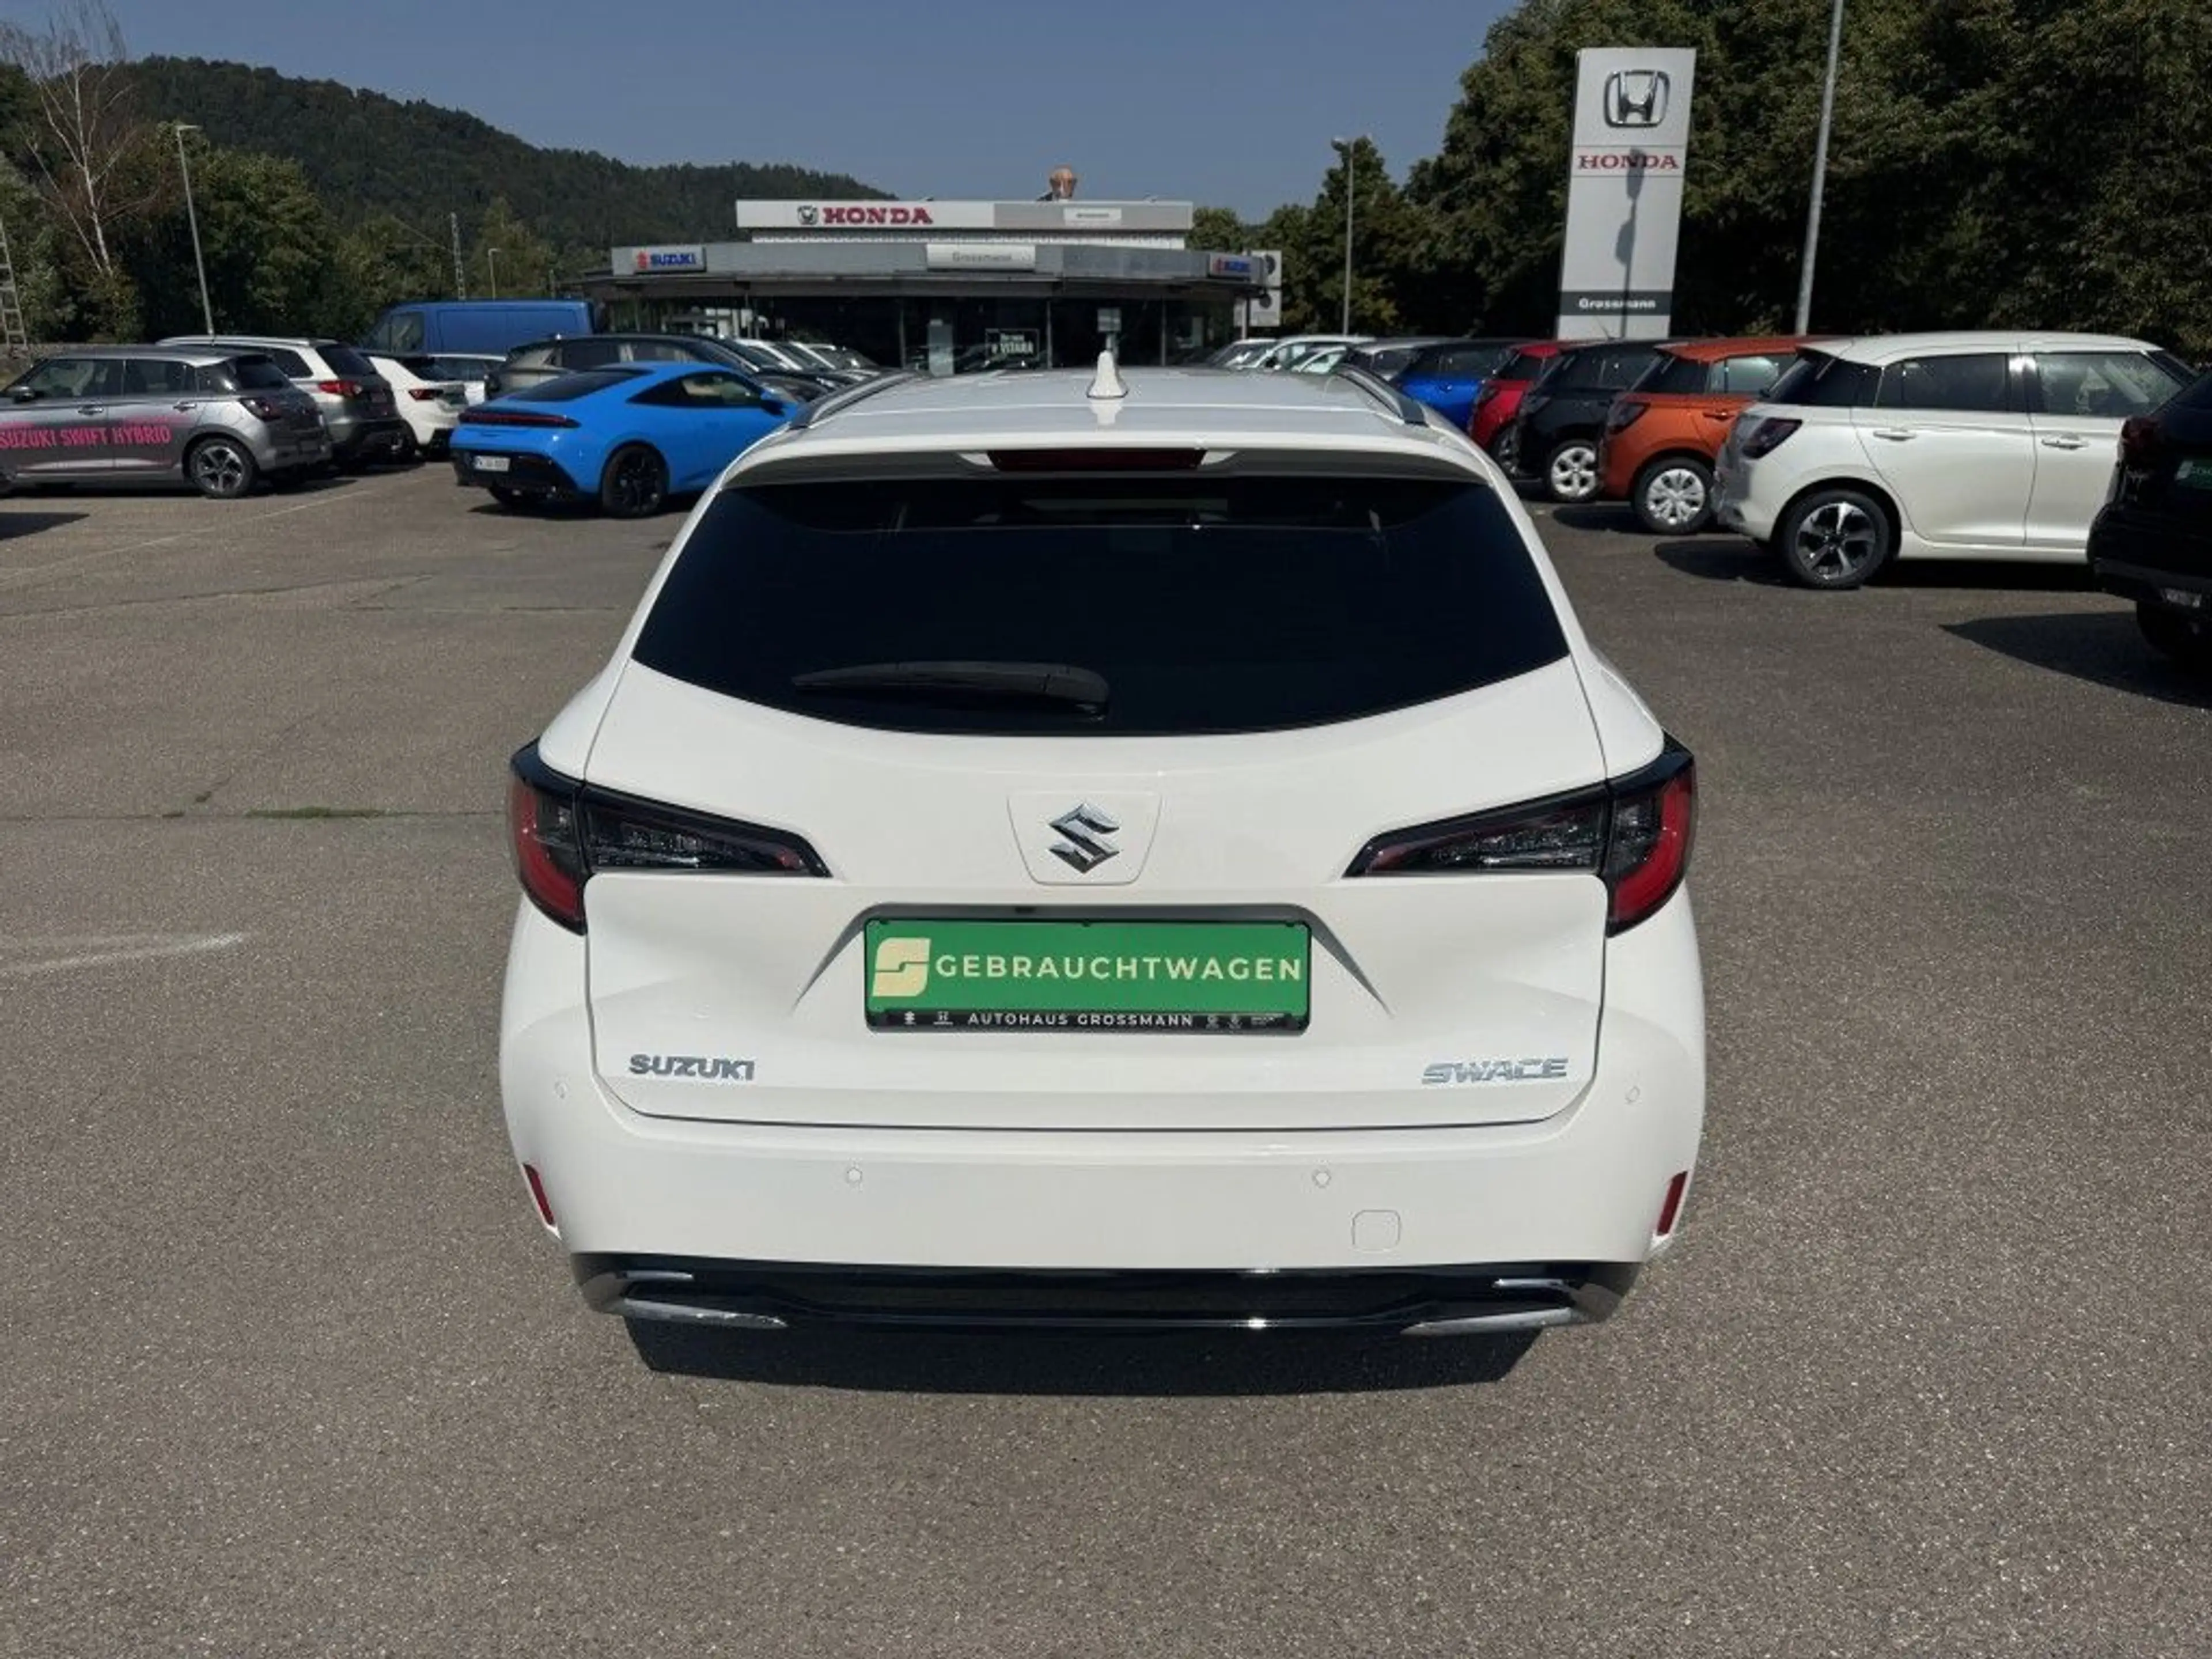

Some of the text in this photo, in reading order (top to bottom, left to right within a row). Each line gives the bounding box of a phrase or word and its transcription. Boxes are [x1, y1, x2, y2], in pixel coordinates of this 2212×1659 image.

[1578, 155, 1680, 169] HONDA
[823, 207, 933, 224] HONDA
[650, 253, 696, 266] SUZUKI
[0, 424, 172, 449] SUZUKI SWIFT HYBRID
[935, 954, 1301, 980] GEBRAUCHTWAGEN
[967, 1012, 1194, 1027] AUTOHAUS GROSSMANN
[630, 1054, 755, 1081] SUZUKI
[1422, 1058, 1568, 1084] SWACE
